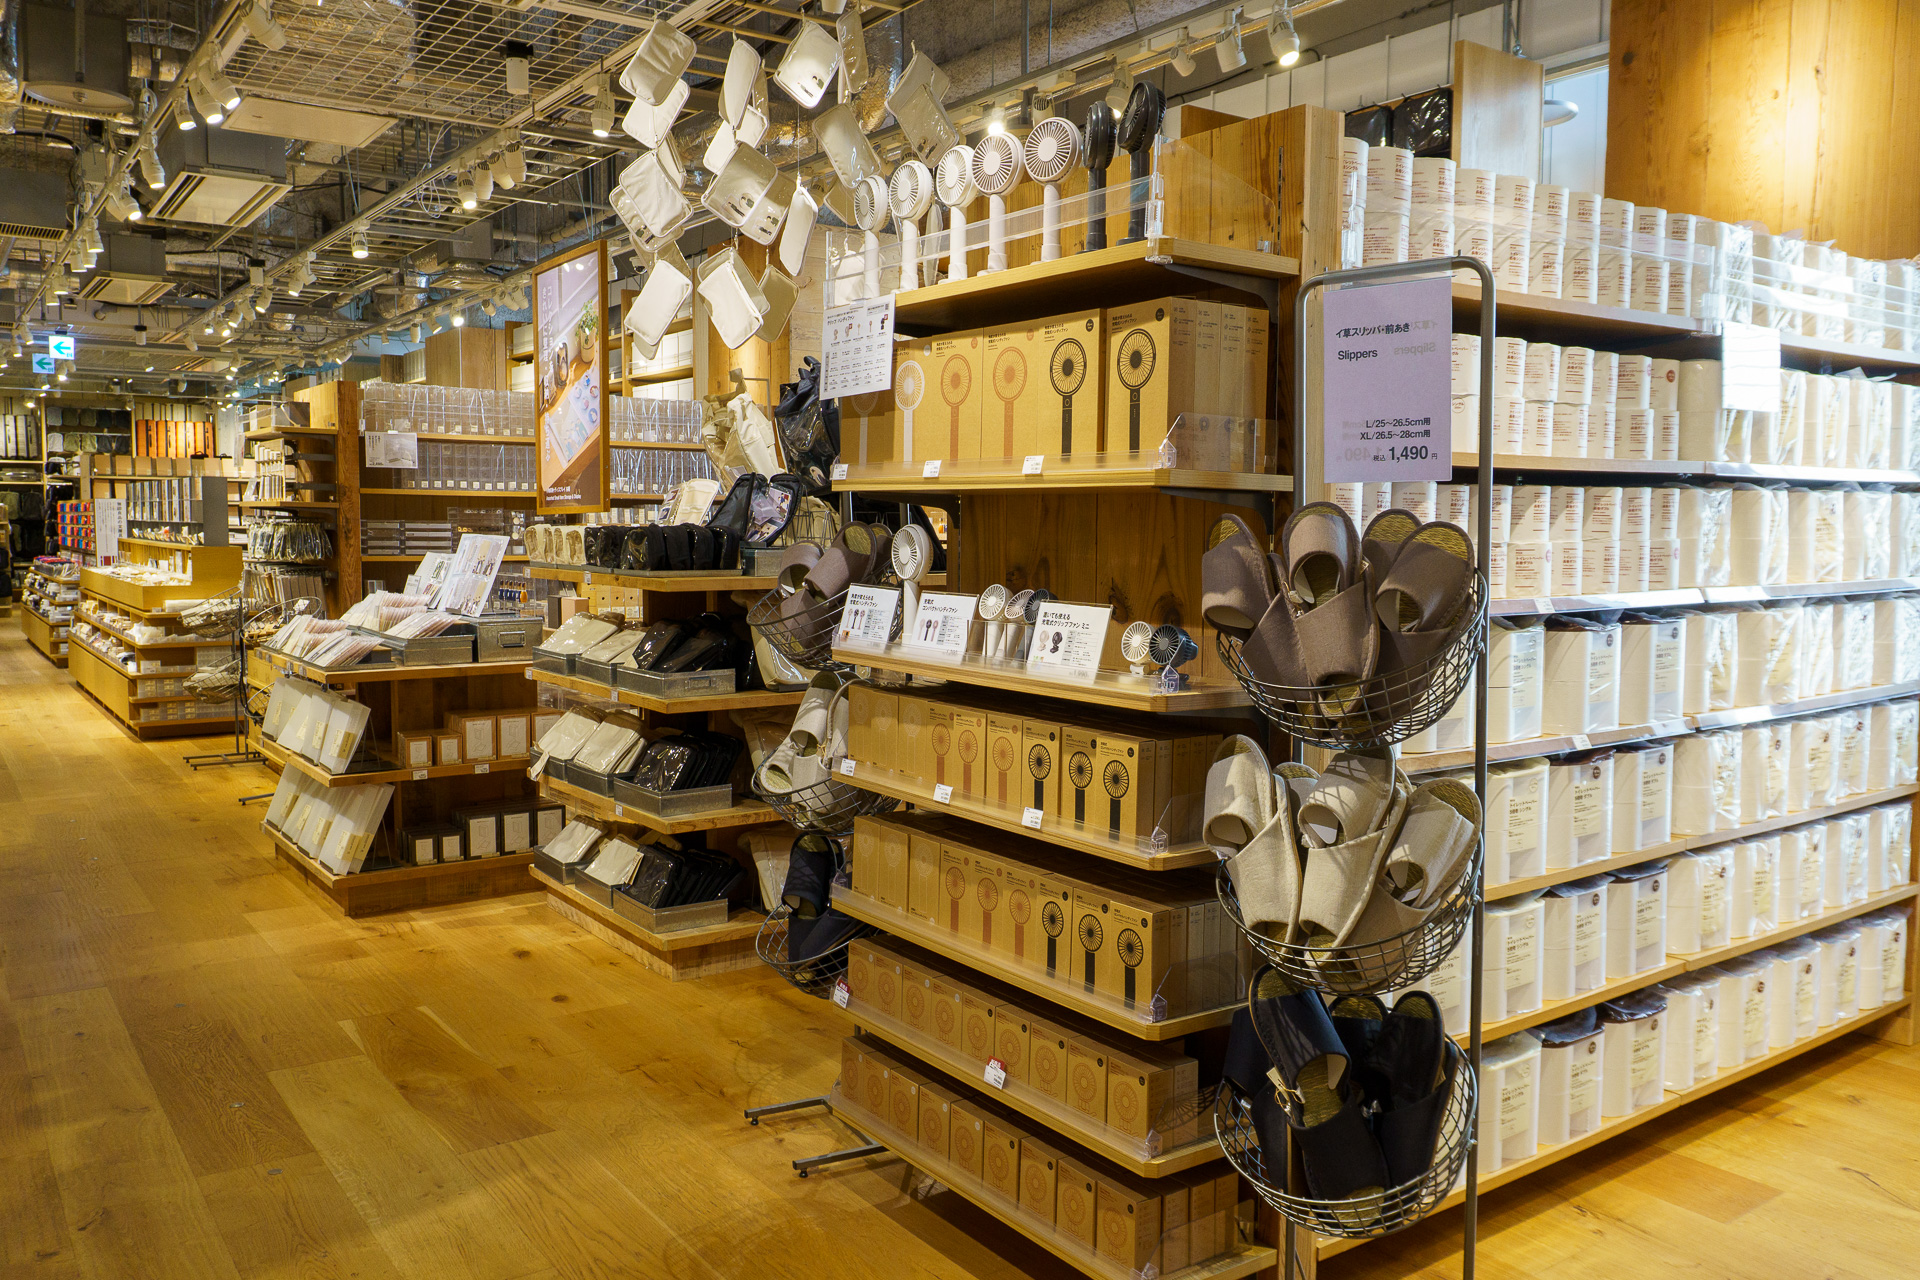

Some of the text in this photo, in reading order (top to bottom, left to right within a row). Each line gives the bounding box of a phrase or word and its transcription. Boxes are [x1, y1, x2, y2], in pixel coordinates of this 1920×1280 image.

[1335, 323, 1410, 338] イ草スリッパ・前あき
[1337, 350, 1378, 361] Slippers
[1389, 446, 1428, 463] 1,490
